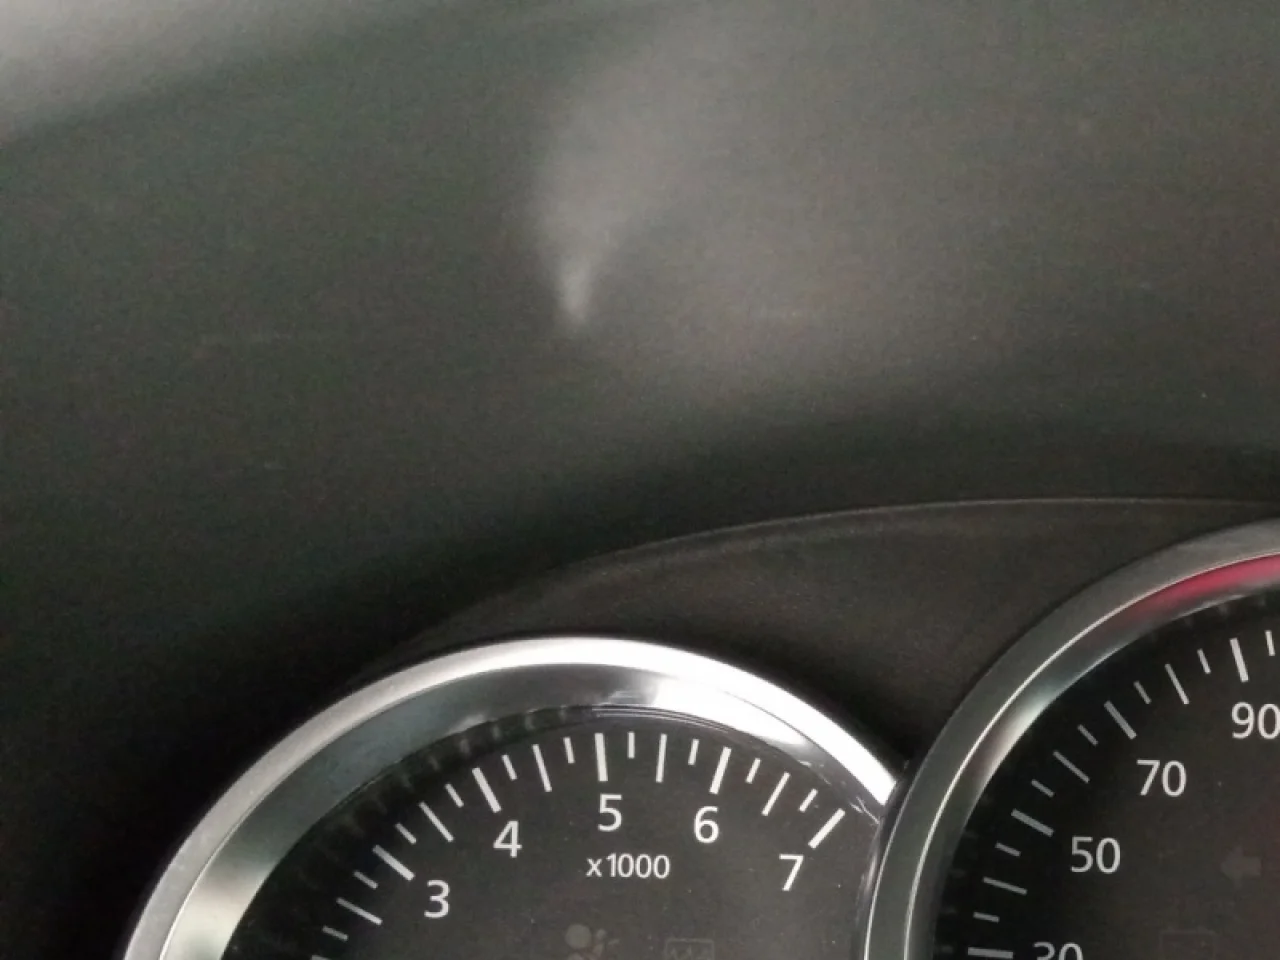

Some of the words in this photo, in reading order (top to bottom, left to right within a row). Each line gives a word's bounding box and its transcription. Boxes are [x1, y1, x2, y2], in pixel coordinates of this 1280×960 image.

[1137, 759, 1187, 797] 70
[598, 793, 622, 832] 5
[693, 805, 720, 844] 6
[493, 820, 523, 858] 4
[1071, 836, 1121, 874] 50
[586, 853, 671, 879] x1000
[778, 853, 804, 892] 7
[424, 879, 450, 919] 3
